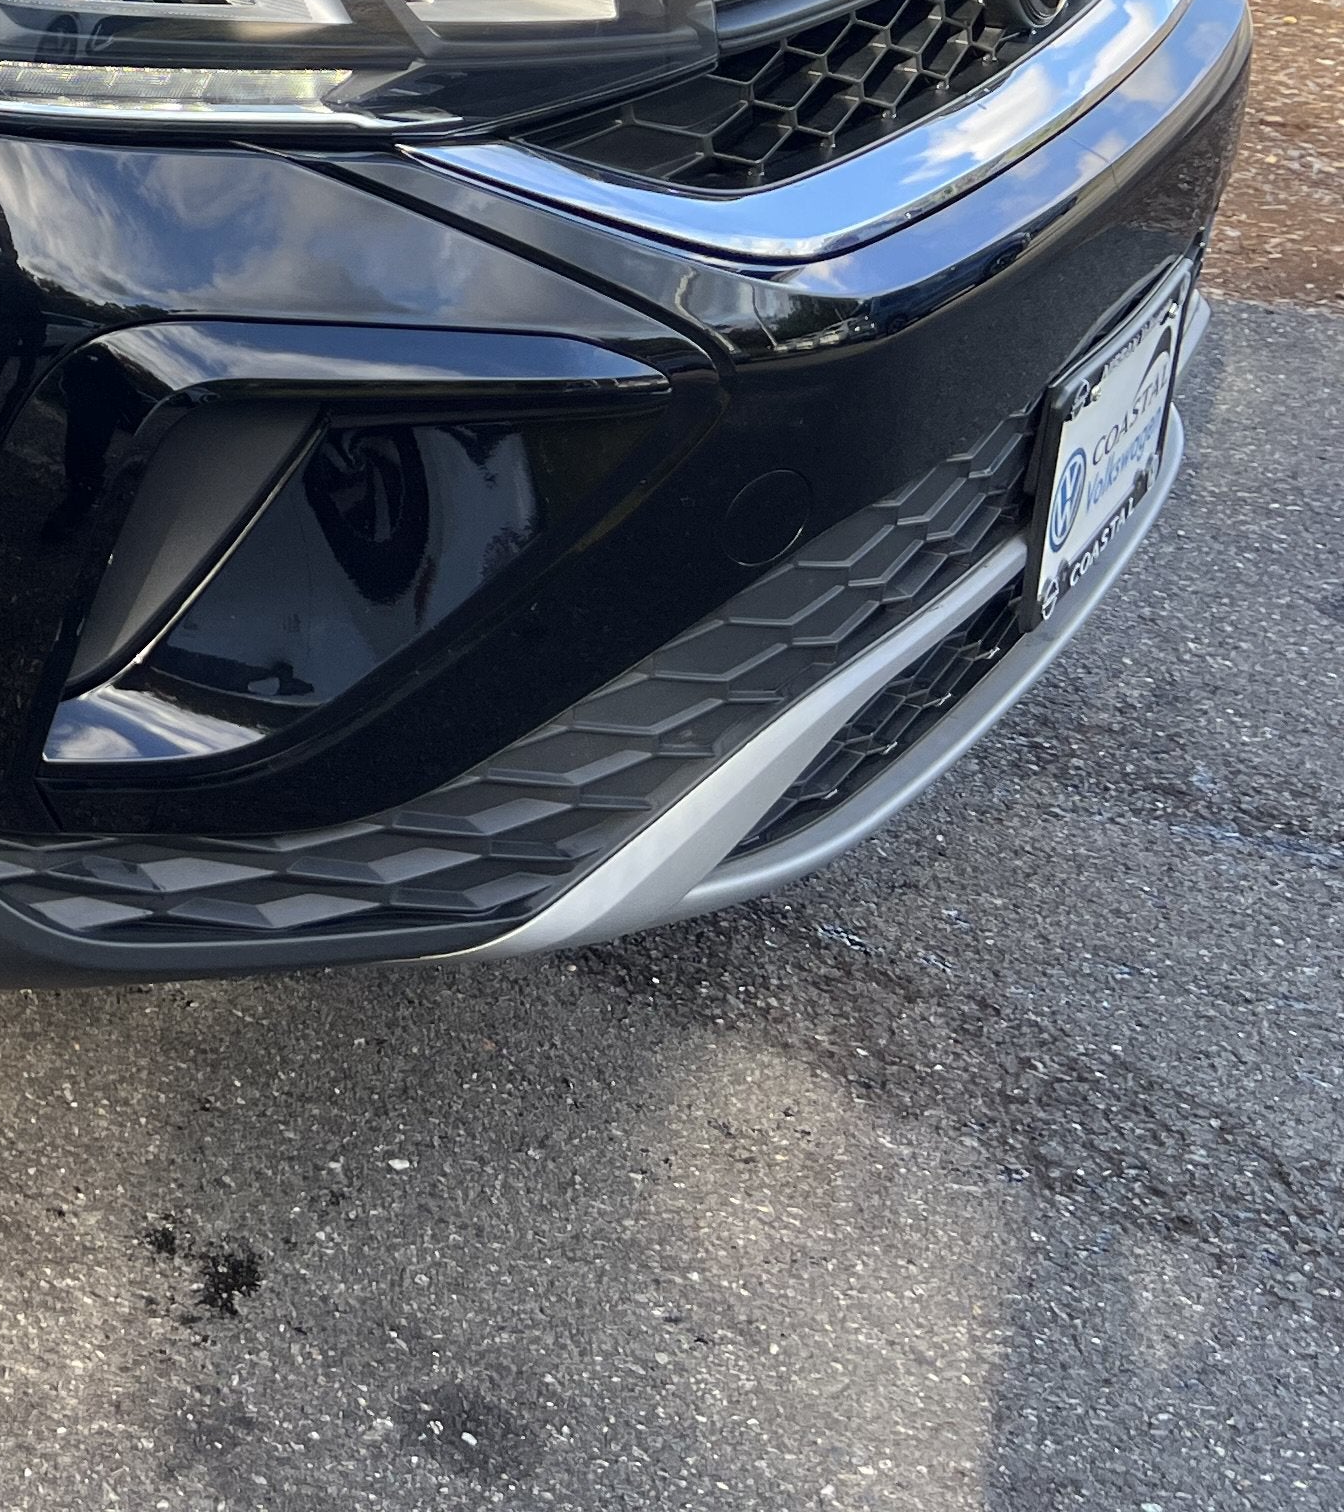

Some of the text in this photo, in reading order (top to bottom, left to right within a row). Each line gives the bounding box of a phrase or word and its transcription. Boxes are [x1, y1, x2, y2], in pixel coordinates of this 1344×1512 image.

[1092, 363, 1167, 465] COASTAL
[1050, 447, 1087, 553] VW
[1070, 497, 1135, 587] COASTAL
